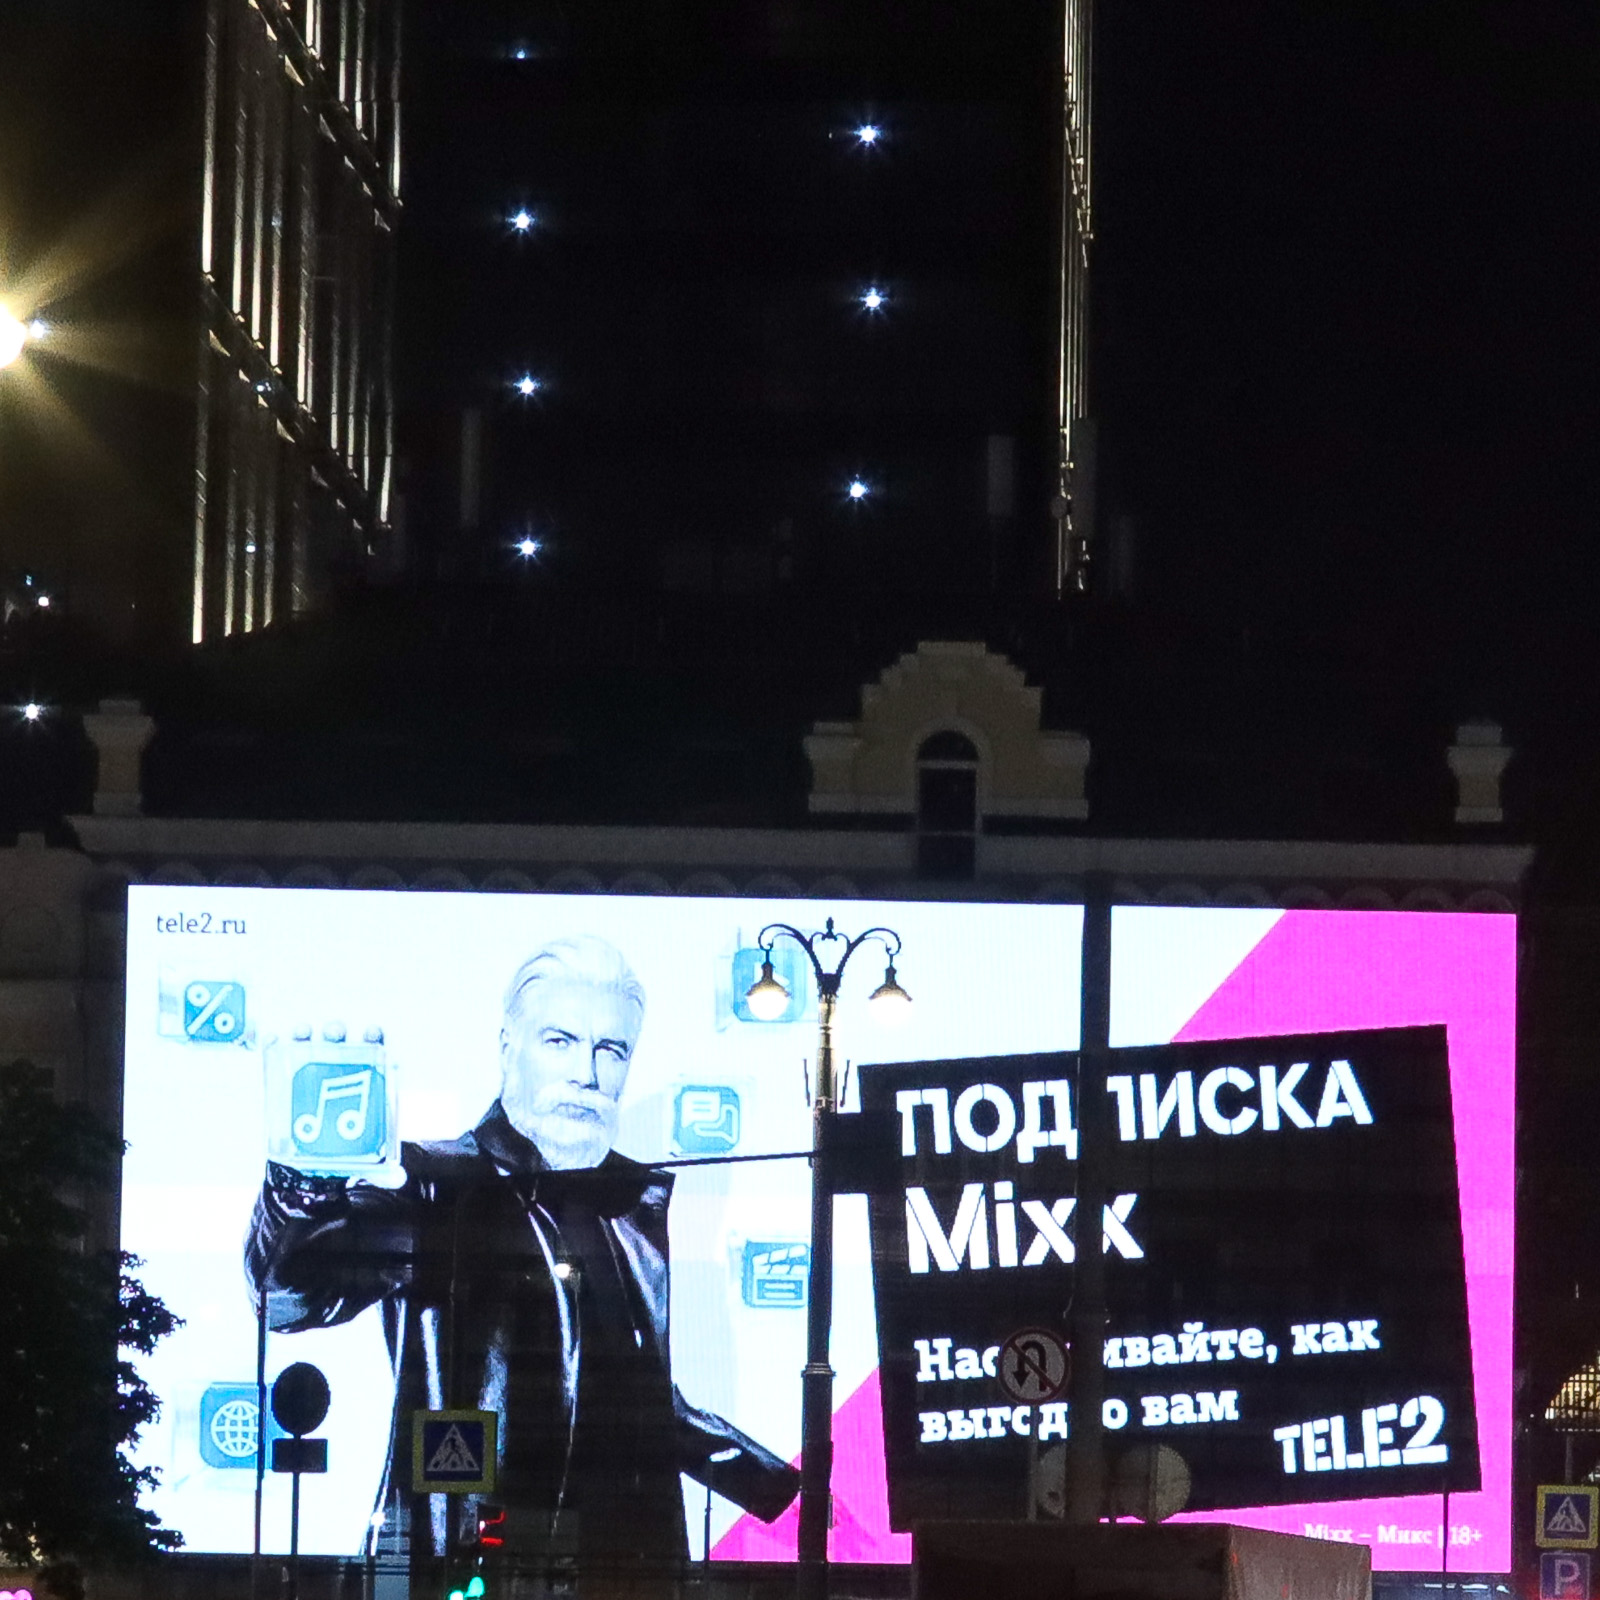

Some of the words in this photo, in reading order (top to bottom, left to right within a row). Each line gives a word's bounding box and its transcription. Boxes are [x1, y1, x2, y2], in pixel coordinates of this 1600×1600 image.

[157, 911, 247, 934] tele2.ru
[904, 1180, 1145, 1275] Mixx
[913, 1322, 1279, 1383] Насивайте,
[1290, 1318, 1381, 1356] как
[918, 1397, 1129, 1443] выгодо
[1140, 1389, 1240, 1428] вам
[1273, 1394, 1450, 1474] TELE2
[1377, 1525, 1433, 1544] Микс
[1449, 1525, 1482, 1546] 18+
